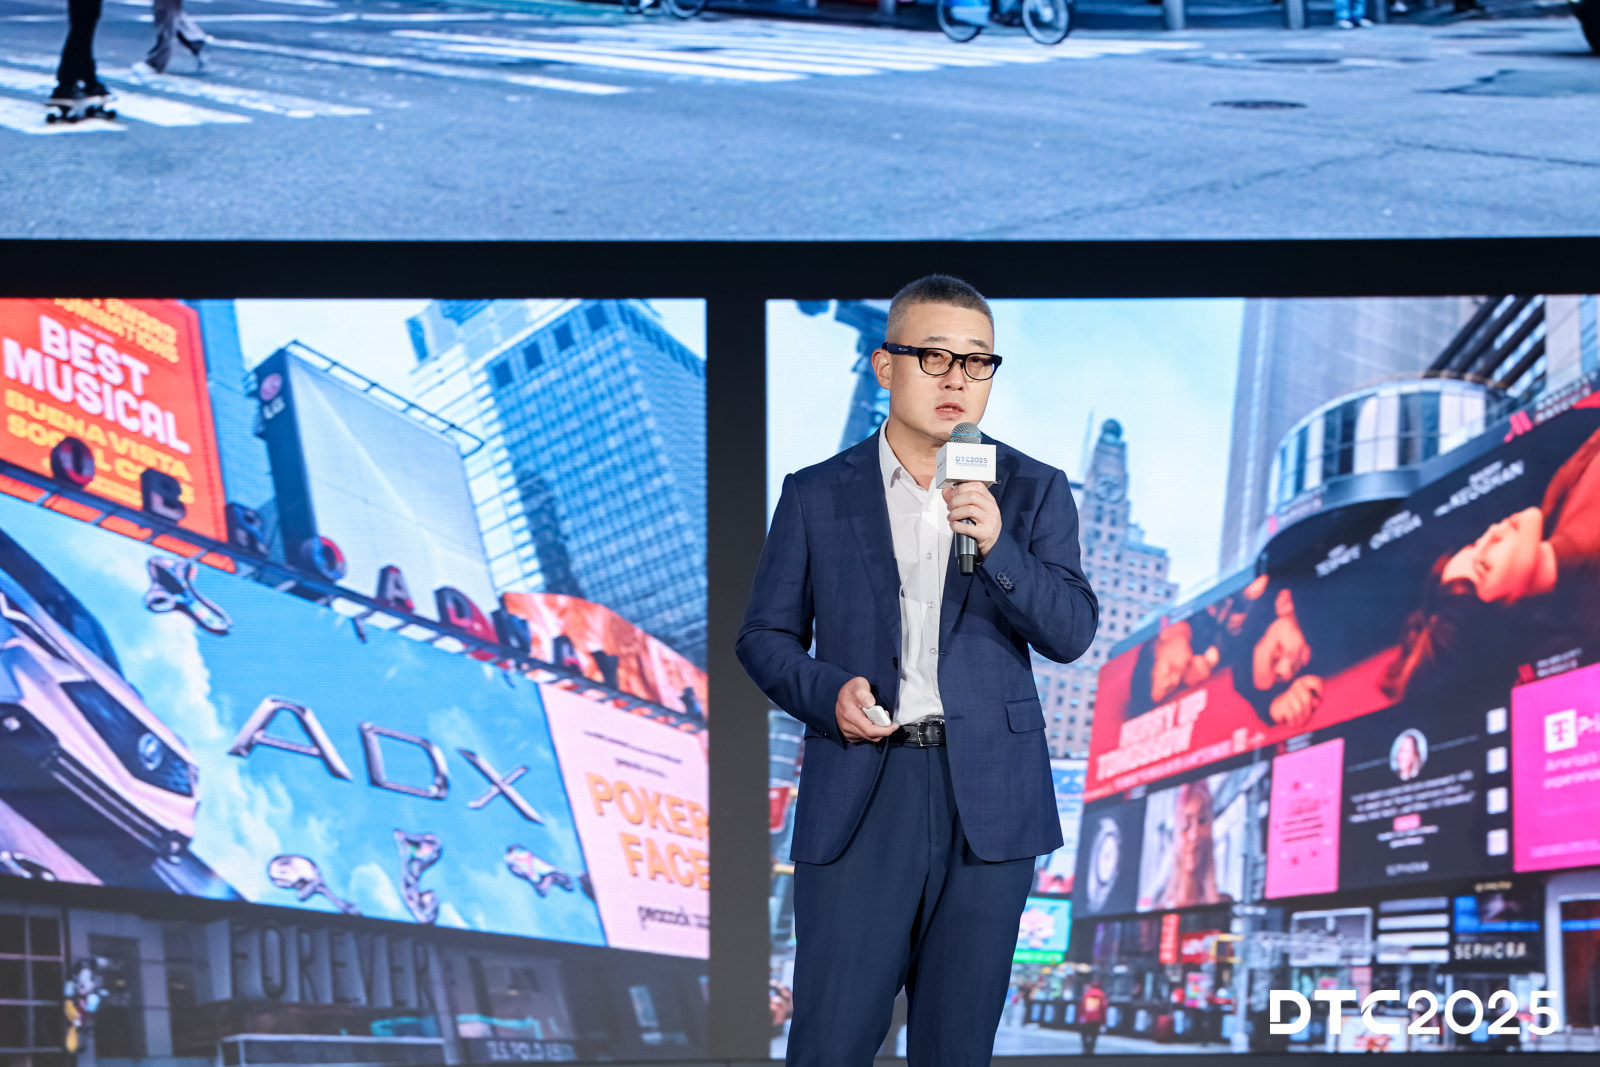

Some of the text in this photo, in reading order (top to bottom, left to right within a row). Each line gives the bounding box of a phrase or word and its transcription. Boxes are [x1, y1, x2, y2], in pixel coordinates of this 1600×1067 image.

[39, 314, 150, 396] BEST
[2, 337, 191, 454] MUSICAL
[262, 397, 286, 419] LG
[5, 388, 193, 482] BUENA VISTA
[7, 413, 112, 472] SOCL
[955, 456, 988, 464] DTC2025
[227, 694, 546, 826] ADX
[585, 771, 709, 841] POKER
[618, 832, 709, 891] FACE
[228, 917, 429, 1006] FOREVER
